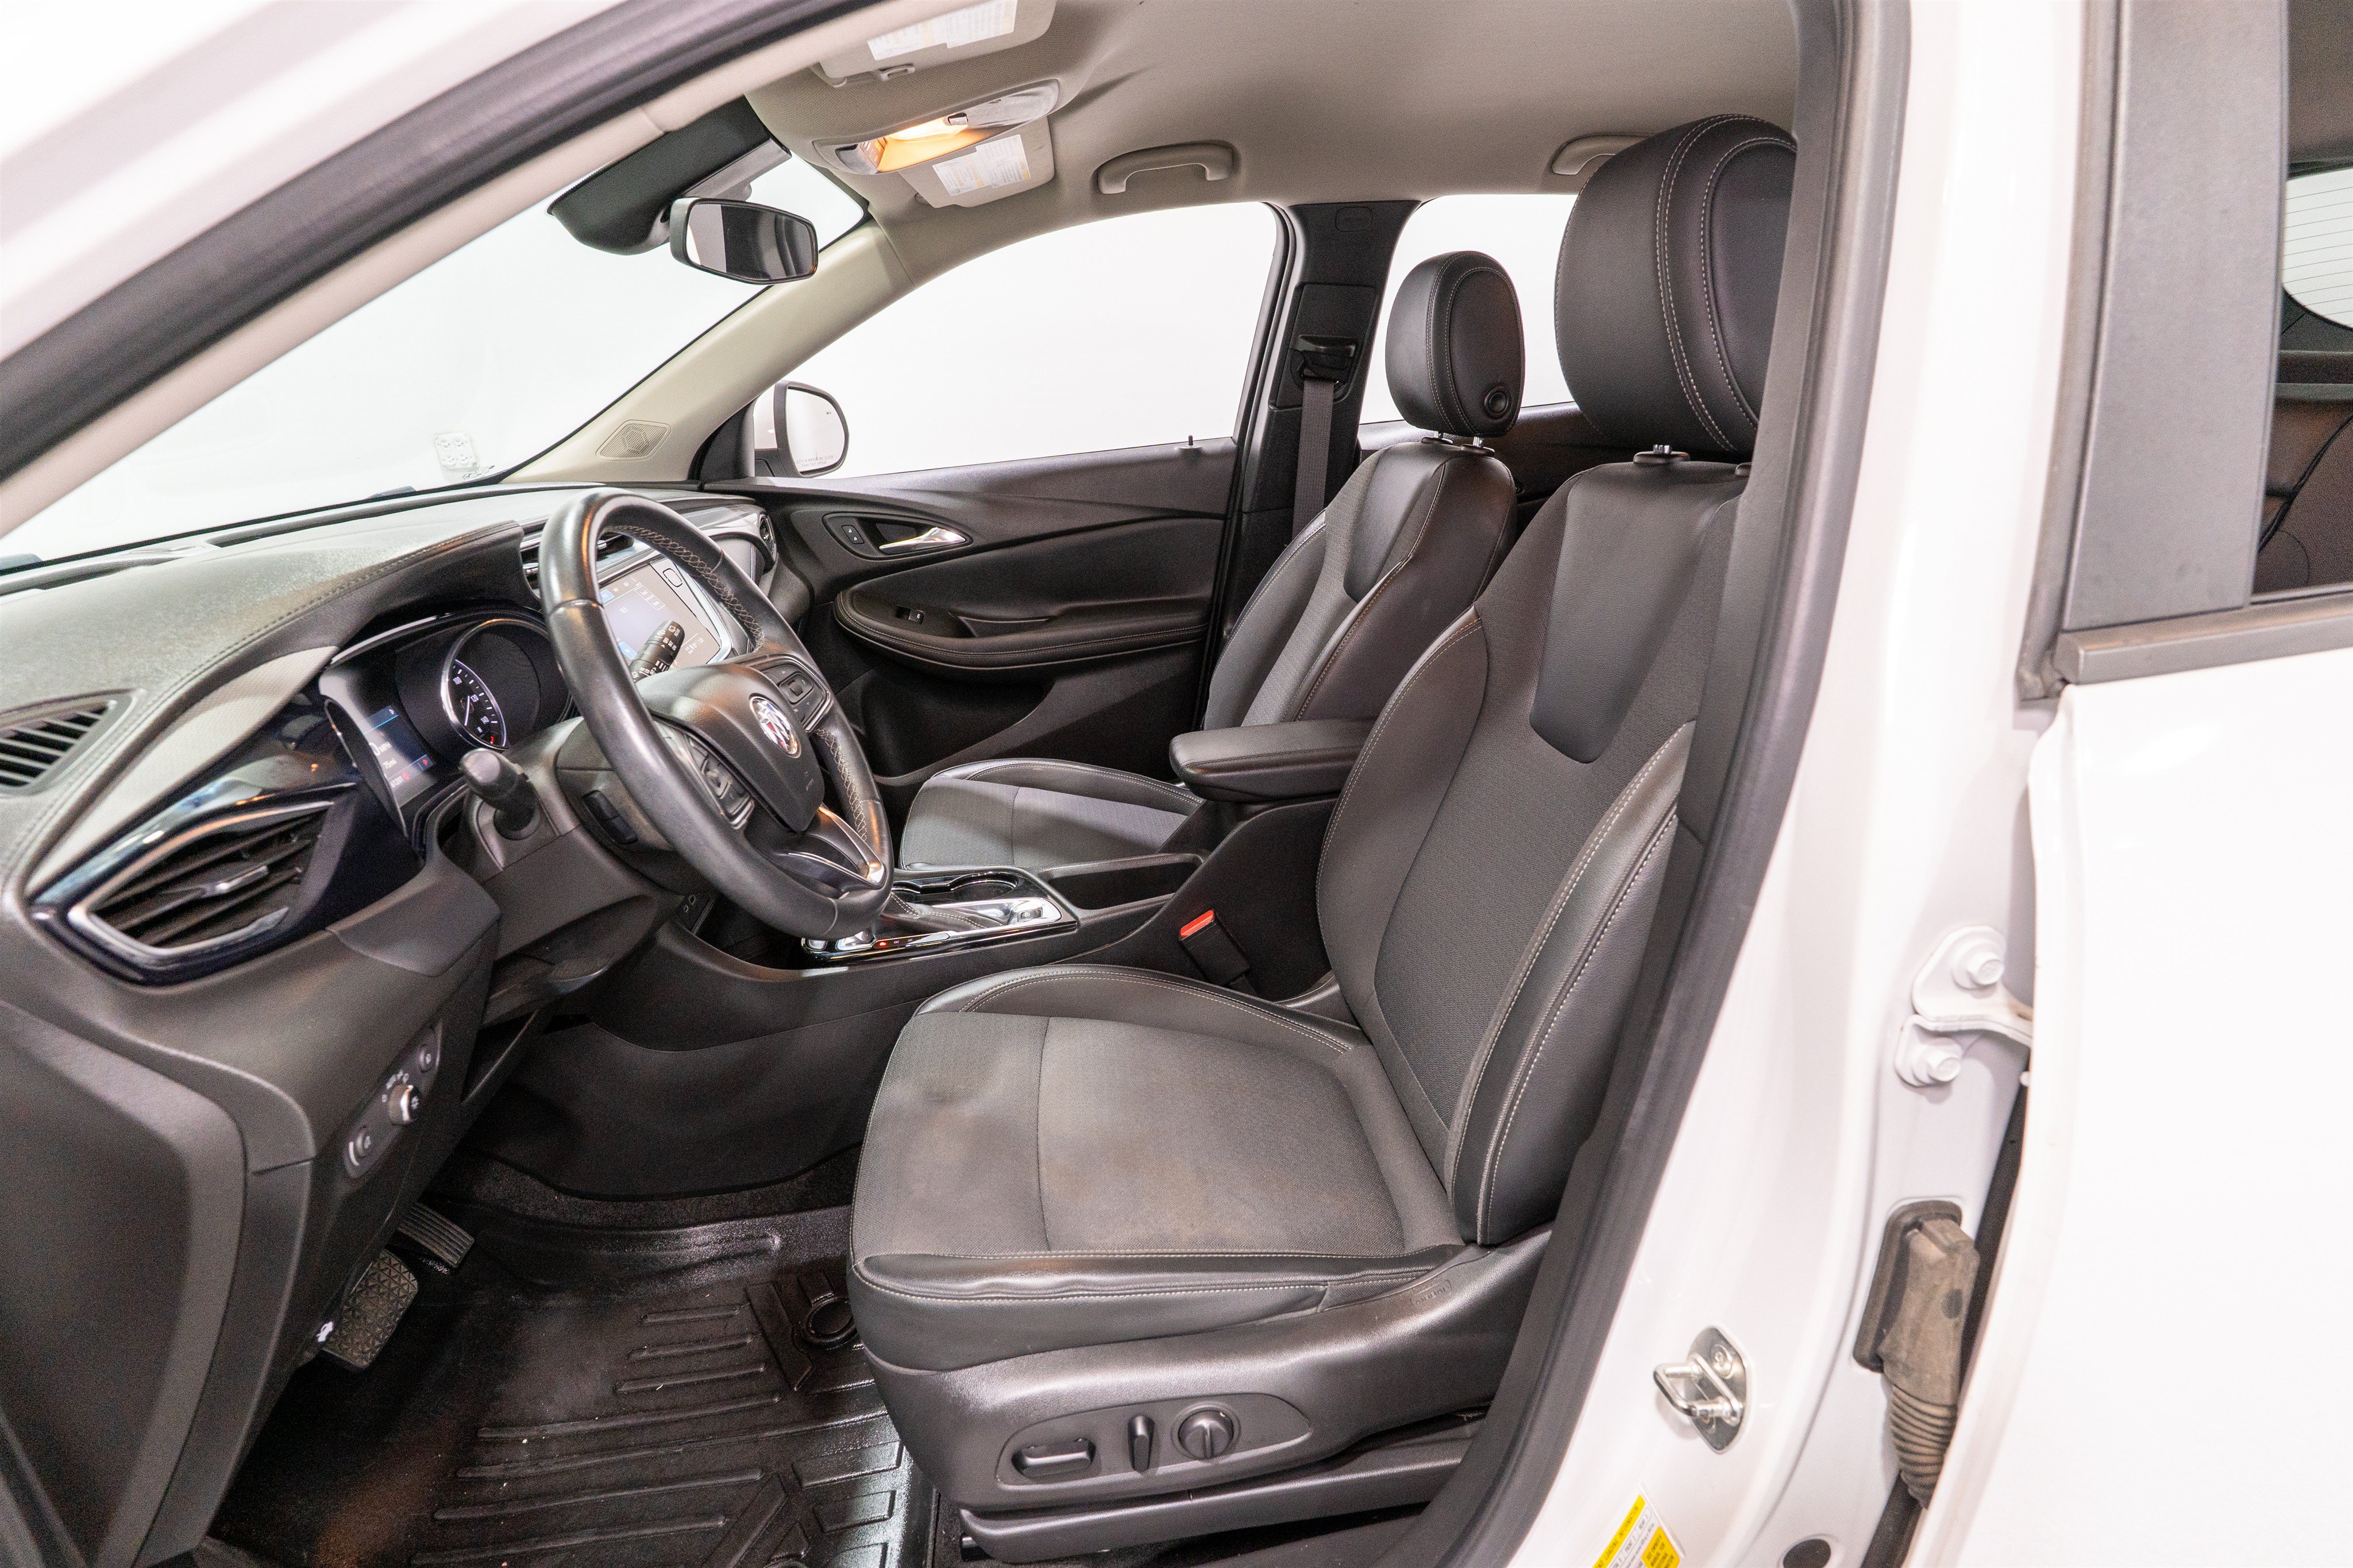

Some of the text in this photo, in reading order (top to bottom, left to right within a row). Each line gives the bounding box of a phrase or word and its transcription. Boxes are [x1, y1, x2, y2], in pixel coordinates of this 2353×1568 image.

[453, 676, 462, 685] 100
[470, 694, 479, 703] 120
[480, 716, 489, 724] 140
[1603, 1538, 1619, 1561] LOADING
[1618, 1506, 1638, 1539] INFORMATION
